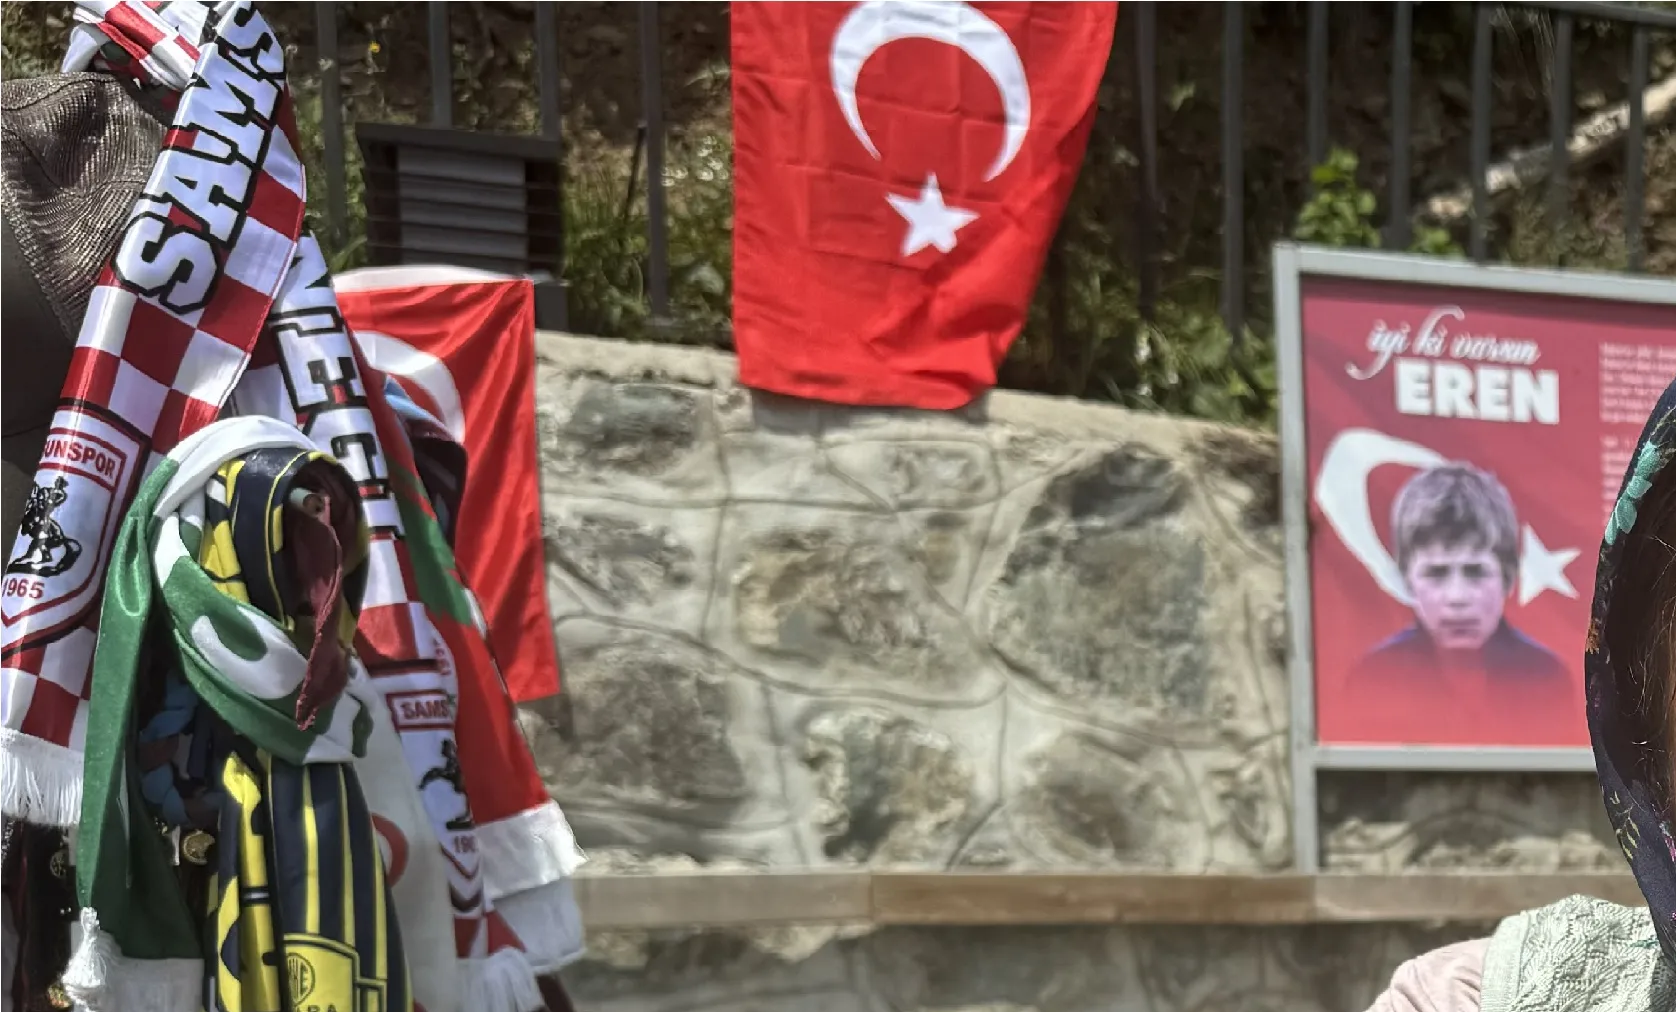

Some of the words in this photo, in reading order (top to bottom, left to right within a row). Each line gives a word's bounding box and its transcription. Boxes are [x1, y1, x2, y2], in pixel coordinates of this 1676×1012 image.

[1412, 305, 1465, 357] ki
[1394, 357, 1560, 425] EREN
[2, 577, 45, 599] 1965
